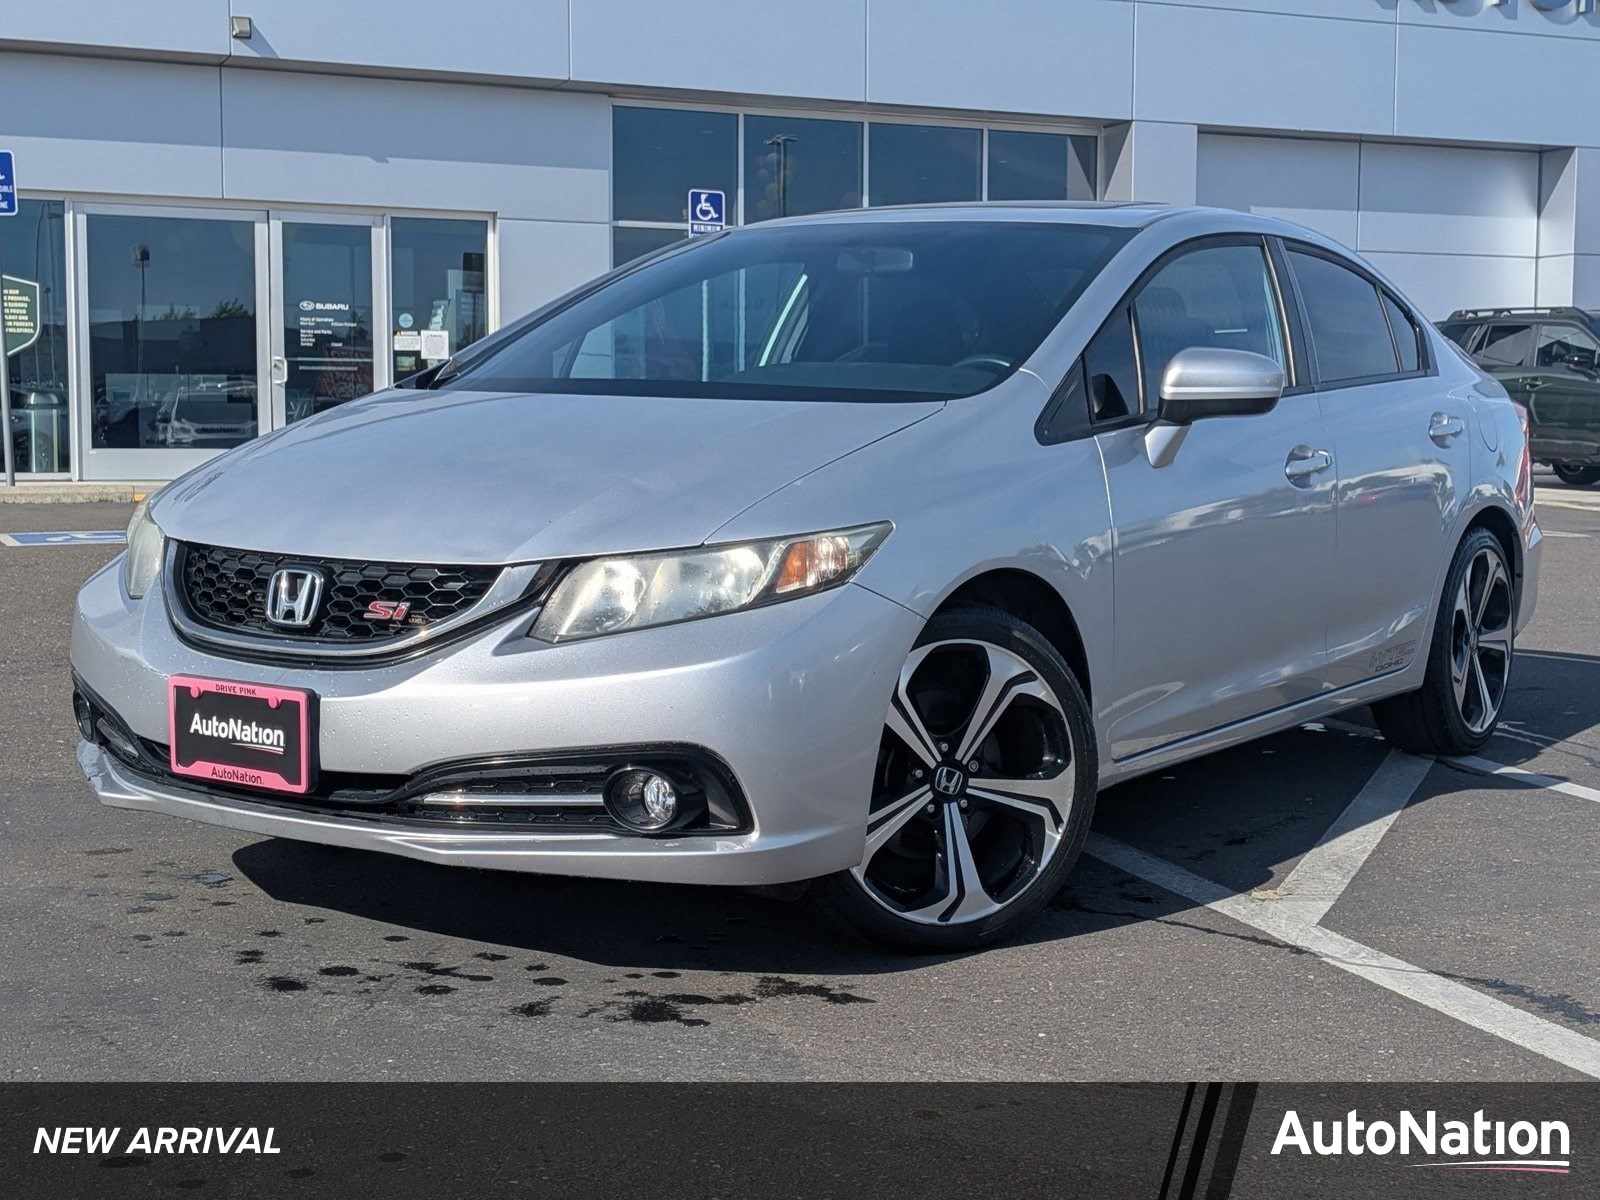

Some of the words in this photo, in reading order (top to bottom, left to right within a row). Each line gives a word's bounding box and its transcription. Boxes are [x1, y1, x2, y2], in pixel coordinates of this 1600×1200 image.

[215, 683, 238, 694] DRIVE
[239, 686, 257, 696] PINK
[189, 712, 285, 747] AutoNation
[211, 766, 263, 784] AutoNation
